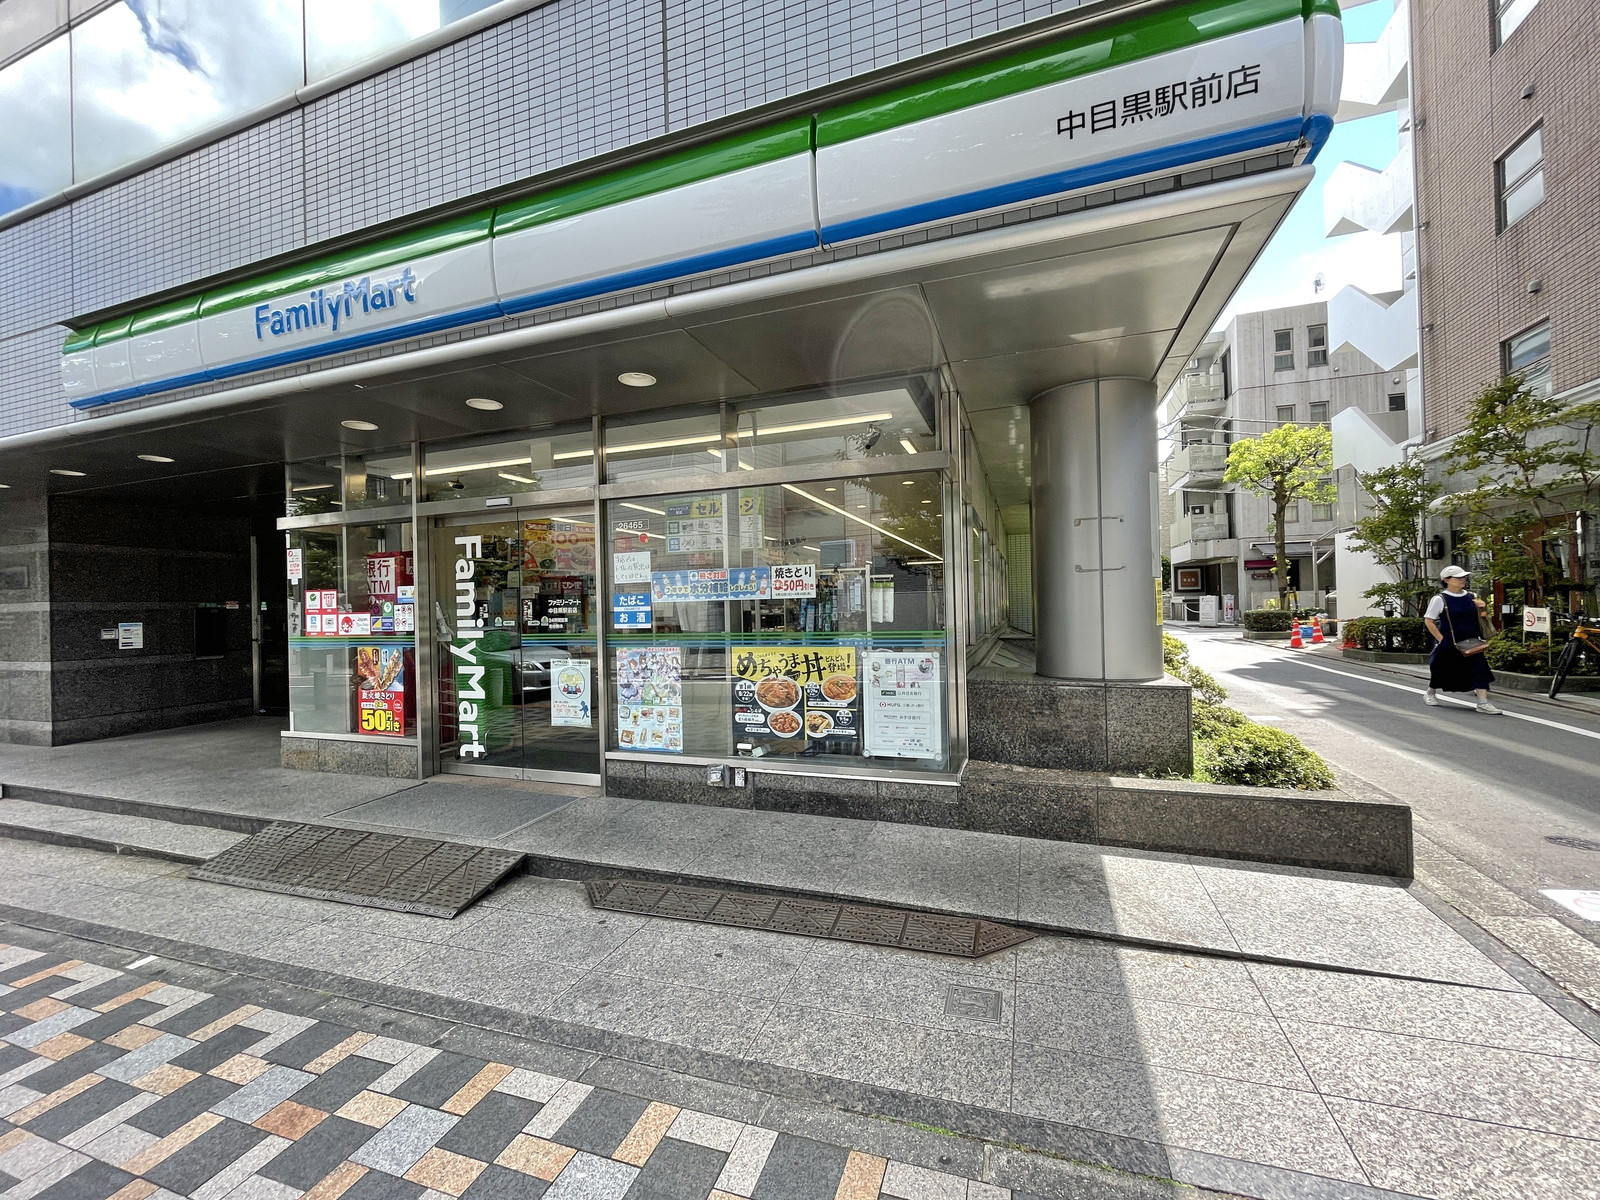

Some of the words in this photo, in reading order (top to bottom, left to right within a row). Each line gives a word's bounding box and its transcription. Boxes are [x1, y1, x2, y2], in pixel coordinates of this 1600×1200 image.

[1056, 63, 1261, 140] 中目黒駅前店
[255, 266, 416, 341] FamilyMart
[618, 521, 643, 529] 26465
[774, 566, 812, 579] 焼きとり
[619, 595, 645, 606] たばこ
[619, 612, 646, 623] お酒
[450, 534, 486, 758] FamilyMart
[736, 651, 826, 683] めちゃうま丼
[362, 709, 401, 732] 50円引き
